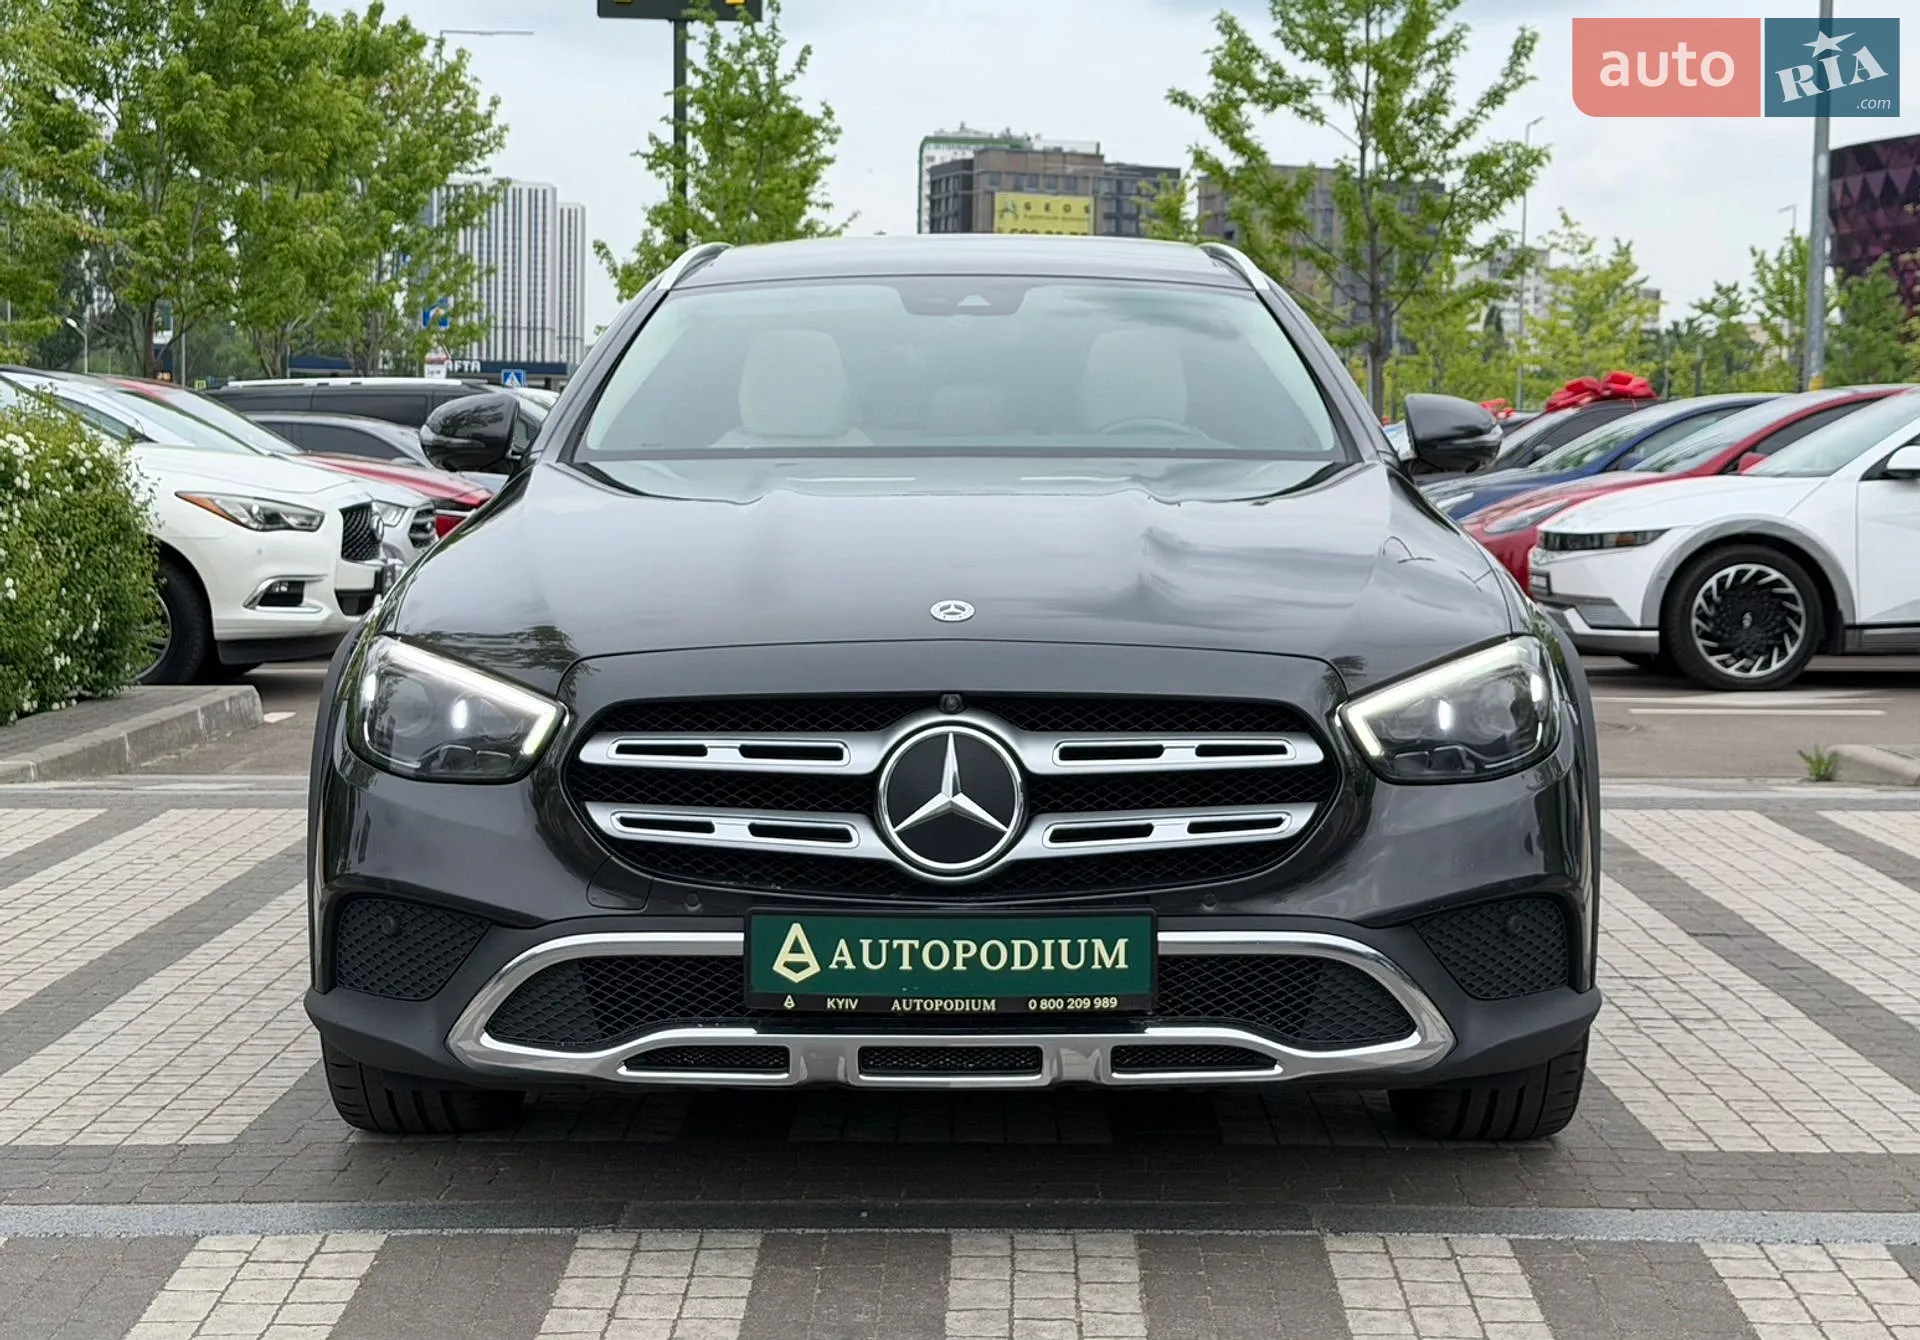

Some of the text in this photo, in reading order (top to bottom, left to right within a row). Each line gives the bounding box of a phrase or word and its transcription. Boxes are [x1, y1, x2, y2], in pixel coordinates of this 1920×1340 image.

[828, 938, 1129, 971] AUTOPODIUM
[826, 996, 1118, 1012] KYIV AUTOPODIUM 0 800 209 989
